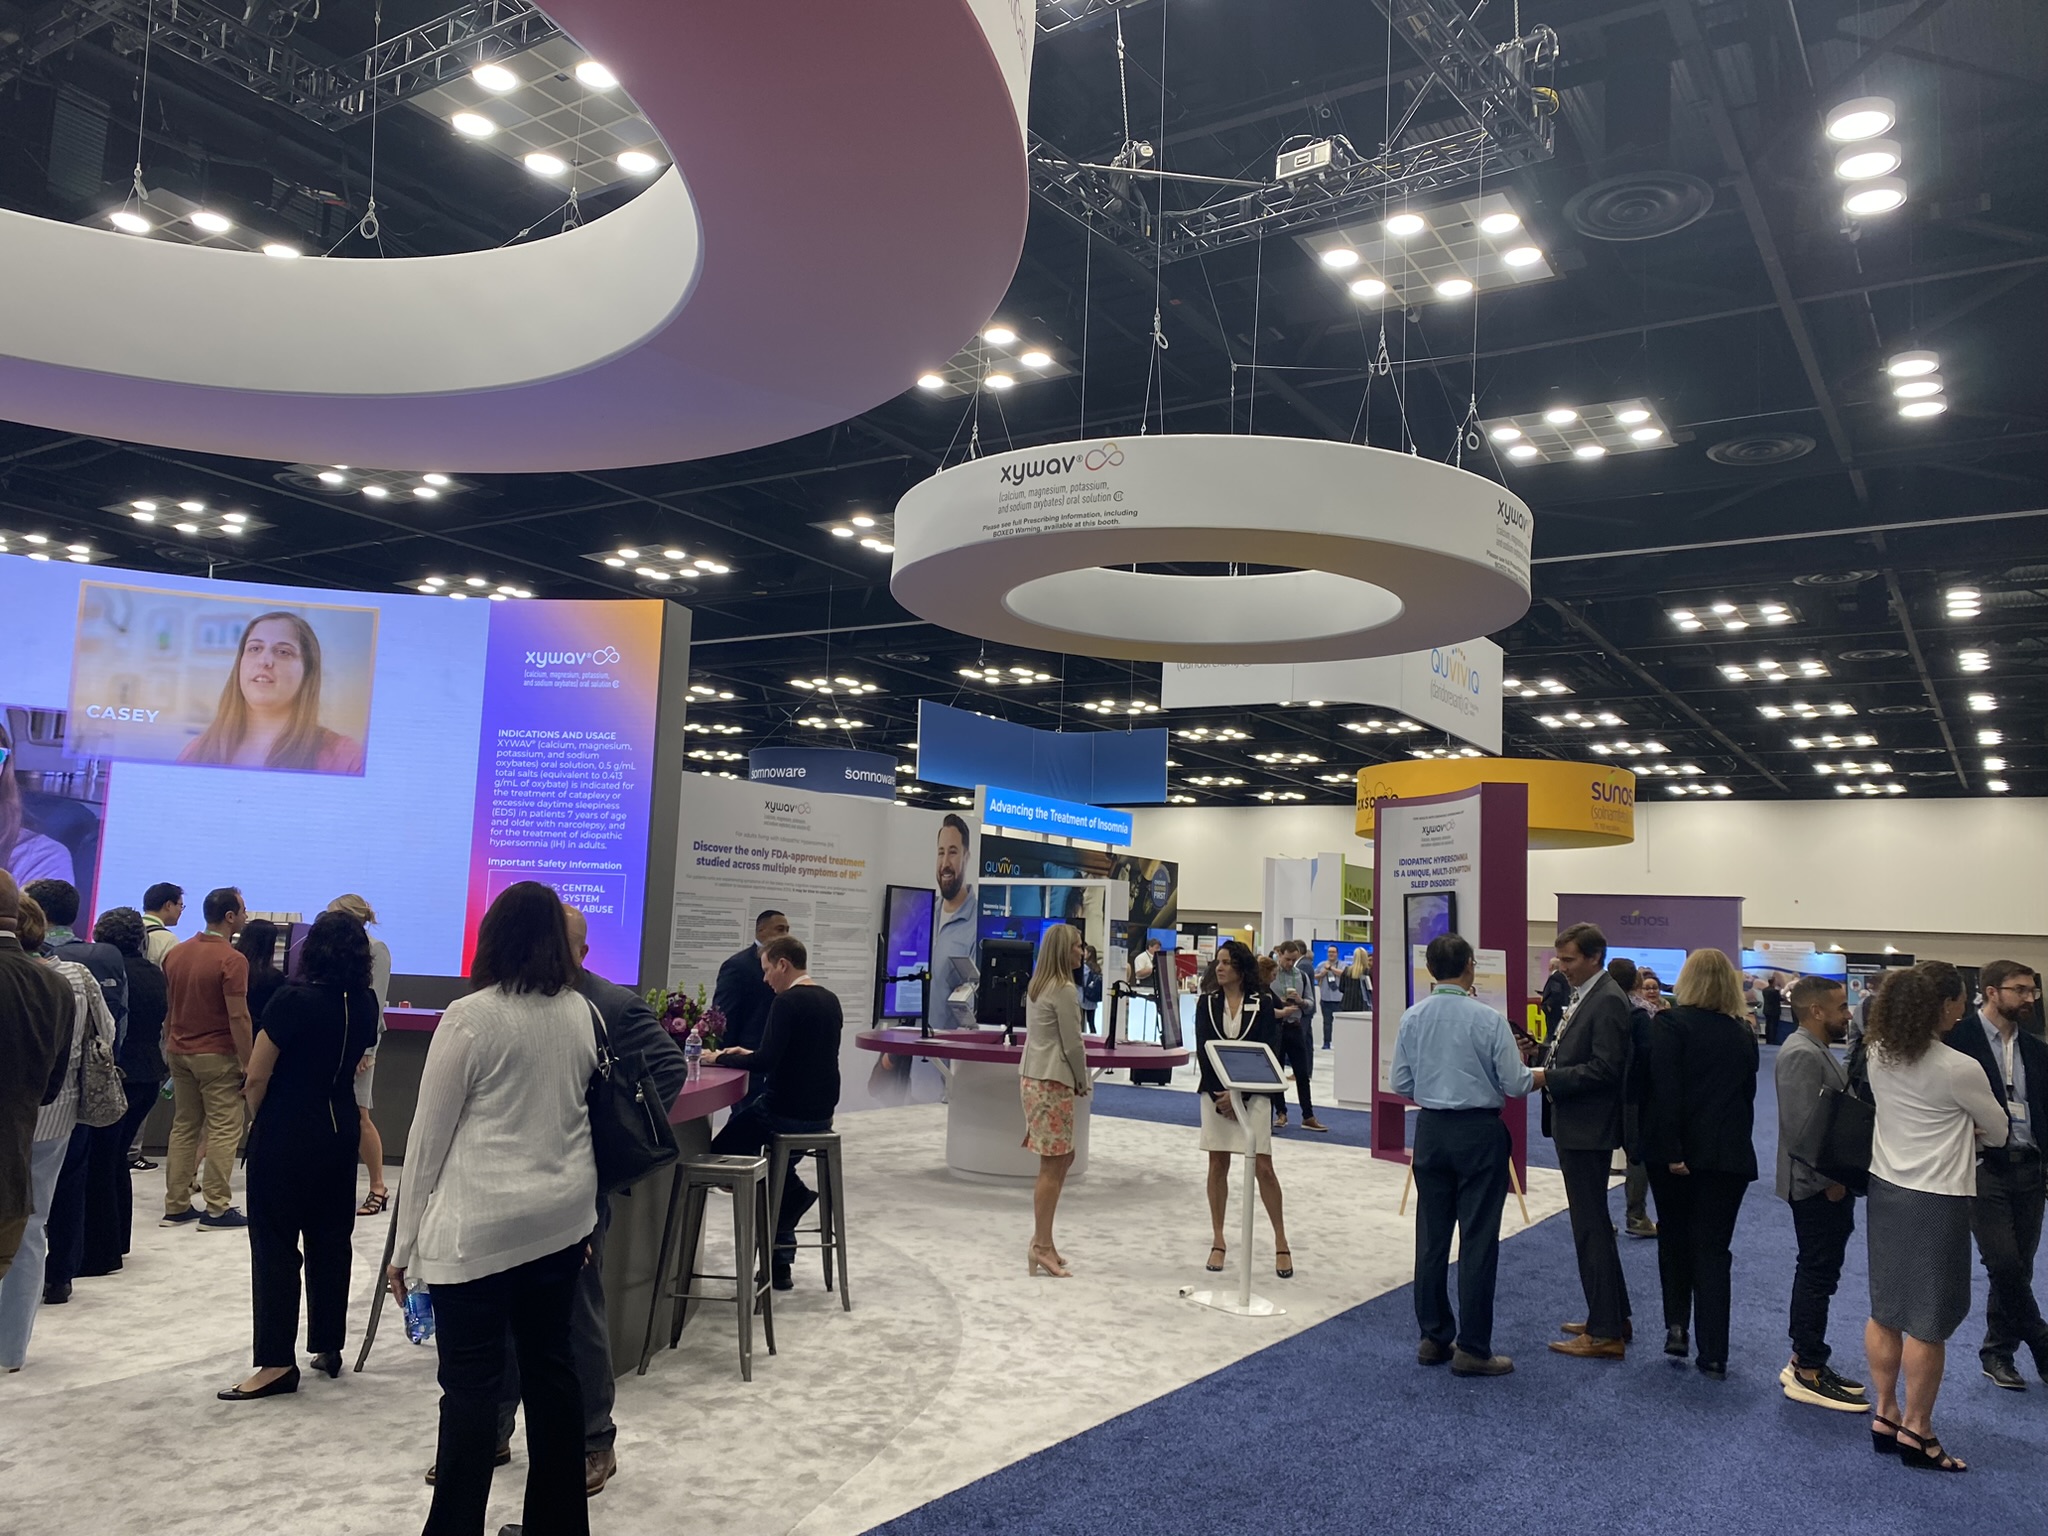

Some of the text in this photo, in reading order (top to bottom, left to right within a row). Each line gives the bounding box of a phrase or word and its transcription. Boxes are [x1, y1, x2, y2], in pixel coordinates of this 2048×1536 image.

[1028, 486, 1068, 498] magnesium,
[1070, 481, 1109, 494] potassium,
[998, 504, 1009, 514] and
[1009, 500, 1031, 512] sodium
[1066, 495, 1080, 505] oral
[1082, 492, 1111, 503] solution
[982, 509, 1138, 532] Please see full Prescribing Information, including
[993, 529, 1015, 538] BOXED
[1015, 525, 1042, 535] Warning,
[1044, 521, 1073, 530] available
[1431, 648, 1479, 694] QUVIVIQ
[523, 679, 534, 687] and
[579, 680, 590, 688] oral
[86, 704, 159, 723] CASEY
[498, 729, 617, 740] INDICATIONS AND USAGE
[538, 741, 577, 749] (calcium,
[579, 743, 632, 751] magnesium,
[496, 750, 546, 759] potassium,
[547, 751, 565, 759] and
[495, 760, 539, 769] oxybates)
[559, 761, 596, 770] solution,
[613, 761, 636, 771] g/mL
[495, 769, 623, 780] total salts (equivalent to 0.413
[751, 766, 807, 779] somnoware
[844, 767, 896, 786] somnoware
[494, 778, 518, 788] g/mL
[520, 779, 530, 787] of
[532, 780, 569, 789] oxybate)
[580, 781, 620, 790] indicated
[622, 782, 634, 790] for
[511, 789, 555, 798] treatment
[558, 790, 567, 798] of
[569, 791, 610, 800] cataplexy
[492, 799, 620, 811] excessive daytime sleepiness
[491, 808, 516, 817] (EDS)
[529, 810, 565, 819] patients
[567, 810, 573, 818] 7
[575, 812, 598, 820] years
[600, 811, 609, 819] of
[611, 813, 627, 821] age
[989, 798, 1129, 834] Advancing the Treatment of Insomnia
[491, 818, 508, 826] and
[511, 819, 534, 827] older
[558, 821, 606, 831] narcolepsy,
[490, 828, 623, 840] for the treatment of idiopathic
[489, 838, 607, 850] hypersomnia (IH) in adults.
[693, 840, 866, 868] Discover the only FDA-approved treatment
[1399, 853, 1468, 866] IDIOPATHIC HYPERSOMNIA
[488, 858, 622, 870] Important Safety Information
[696, 856, 730, 868] studied
[732, 860, 760, 871] across
[762, 862, 797, 874] multiple
[798, 867, 838, 878] symptoms
[839, 869, 848, 878] of
[985, 861, 1020, 875] QUVIVIQ
[1401, 869, 1406, 877] A
[1407, 868, 1431, 878] UNIQUE,
[1432, 865, 1471, 876] MULTI-SYMPTOM
[562, 884, 606, 893] CENTRAL
[1411, 880, 1428, 888] SLEEP
[562, 894, 600, 903] SYSTEM
[582, 905, 614, 914] ABUSE
